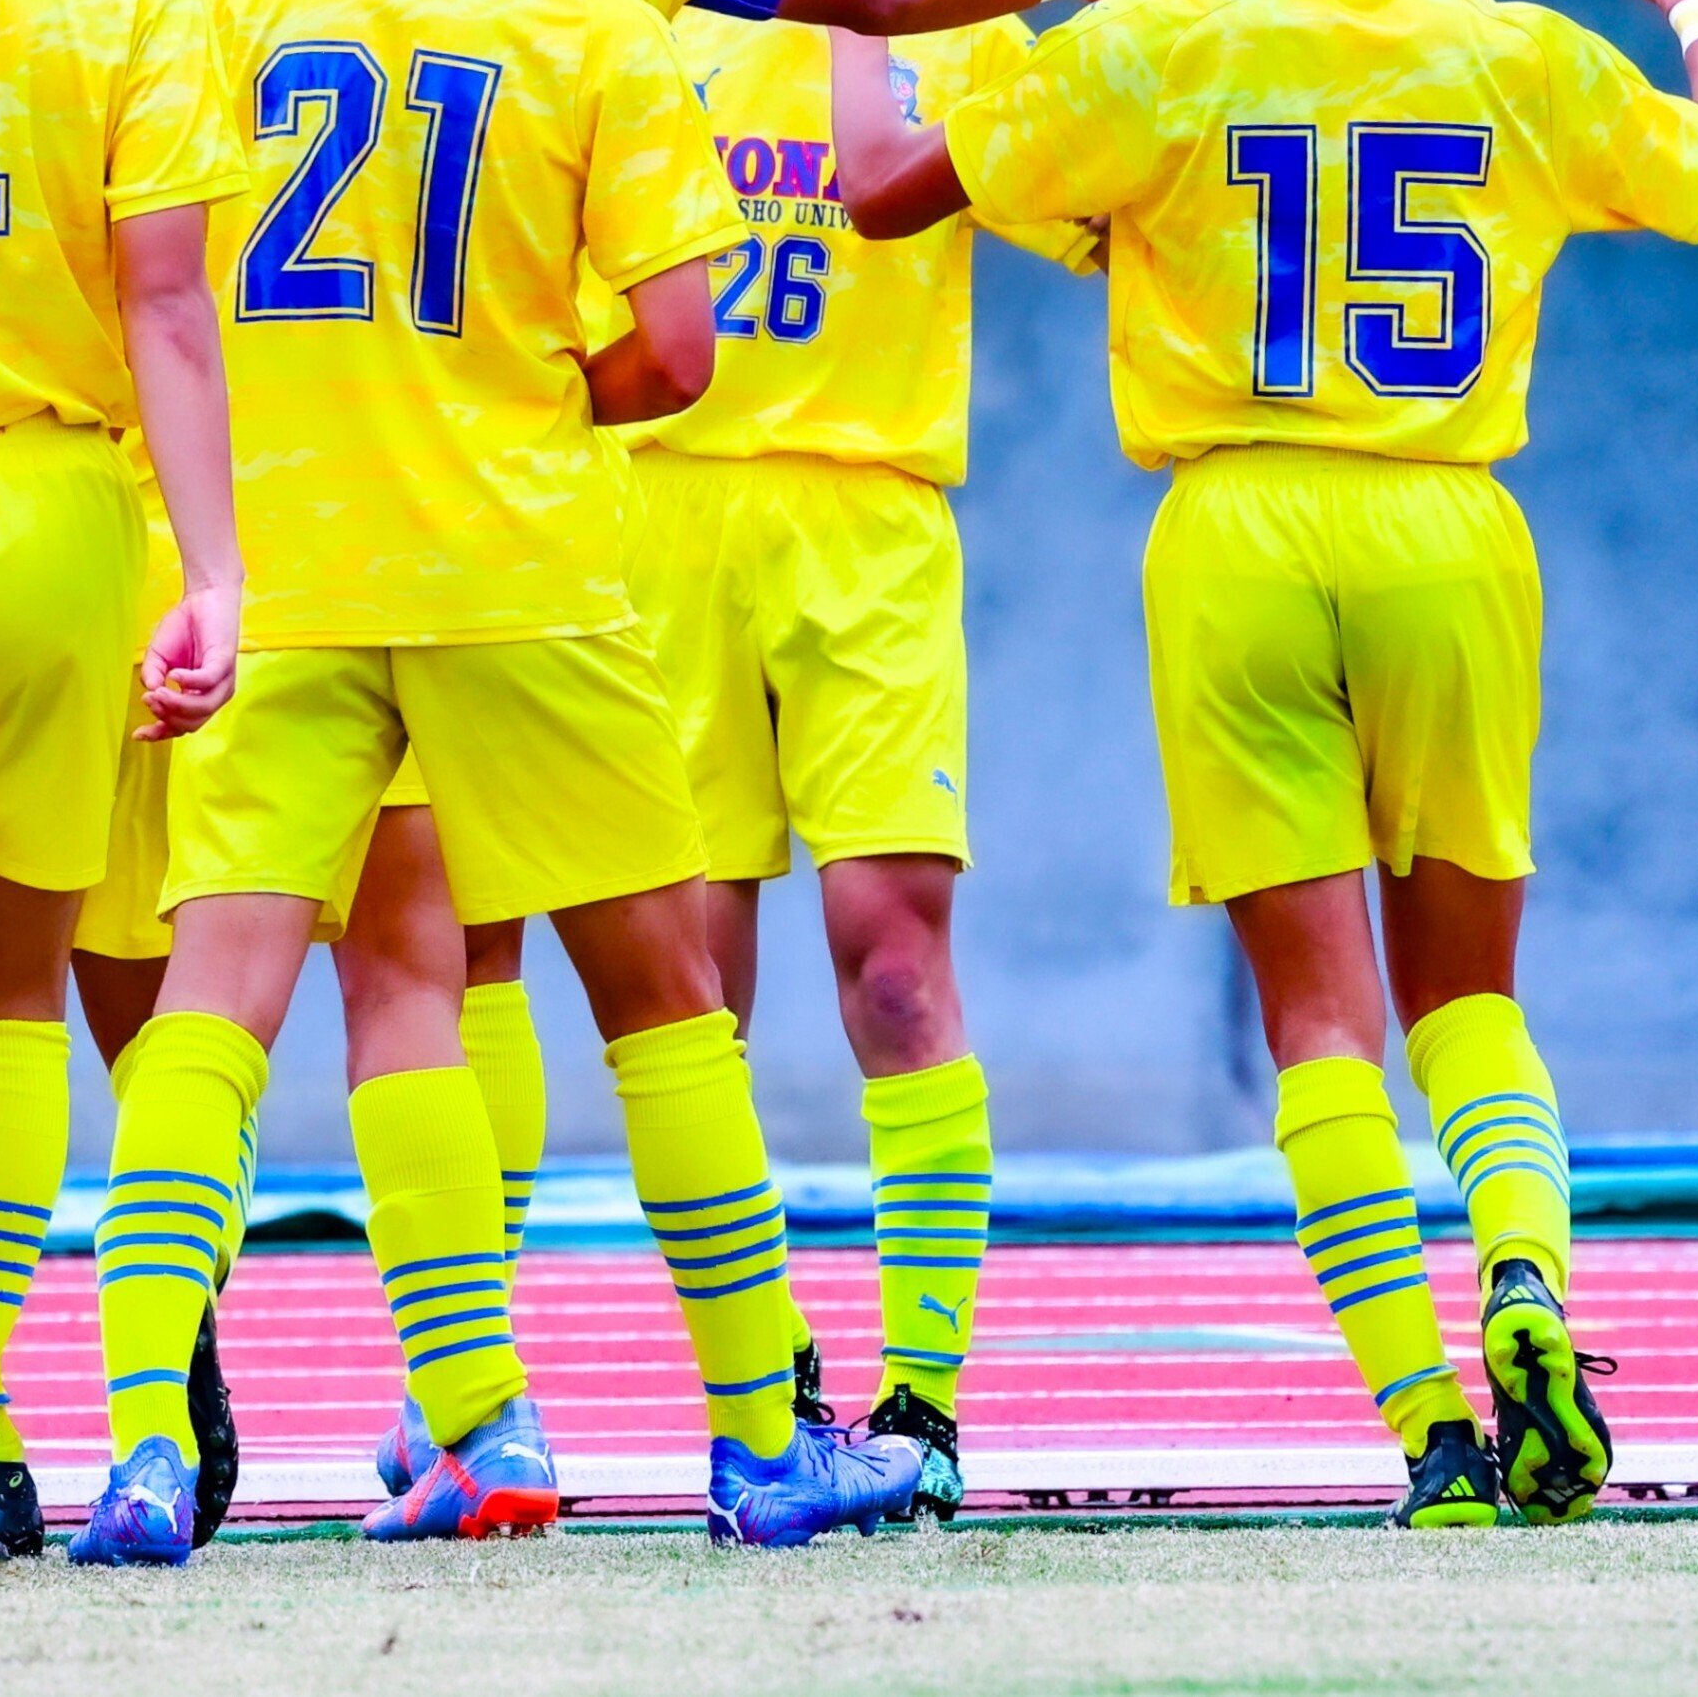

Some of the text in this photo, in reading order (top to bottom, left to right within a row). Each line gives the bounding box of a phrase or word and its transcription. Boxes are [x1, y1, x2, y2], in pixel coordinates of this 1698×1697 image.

[234, 40, 503, 339] 21
[708, 233, 831, 345] 26
[1227, 121, 1493, 399] 15
